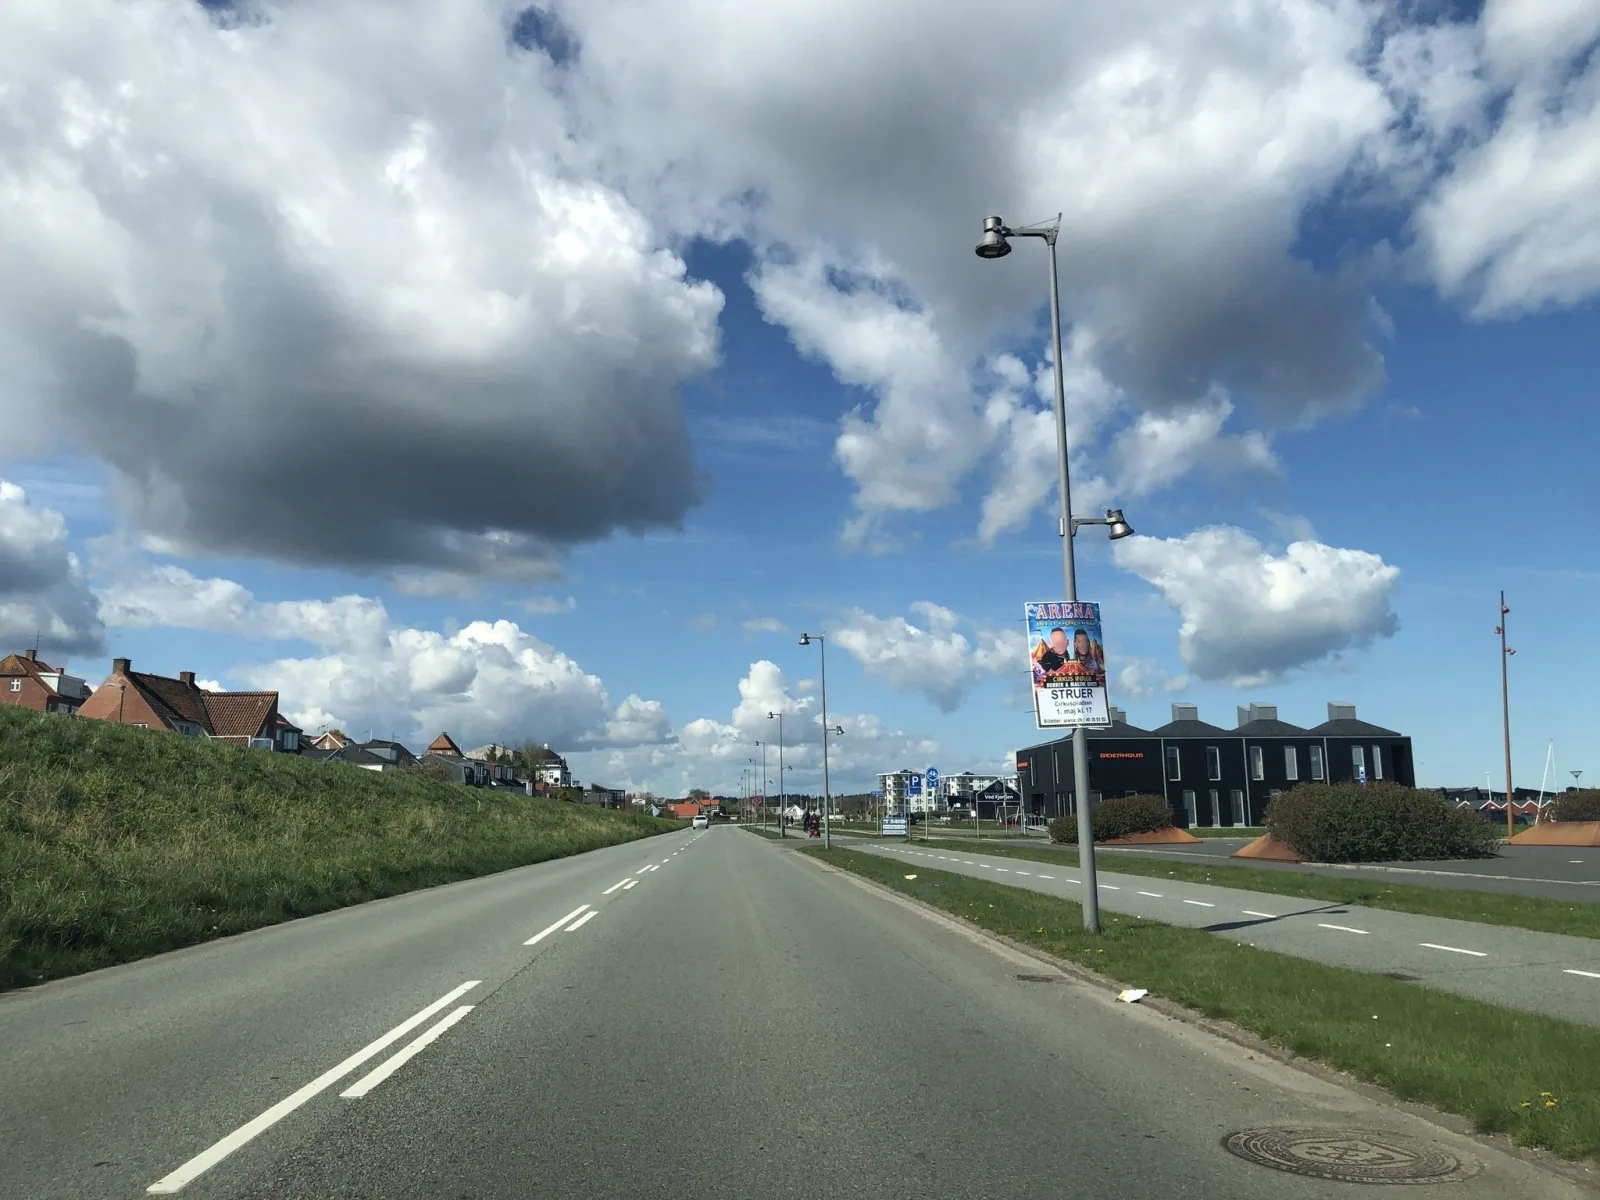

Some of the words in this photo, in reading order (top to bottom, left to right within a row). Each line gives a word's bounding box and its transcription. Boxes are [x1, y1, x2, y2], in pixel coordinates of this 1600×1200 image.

[1035, 603, 1095, 619] ARENA
[1051, 688, 1093, 699] STRUER
[911, 776, 919, 785] P
